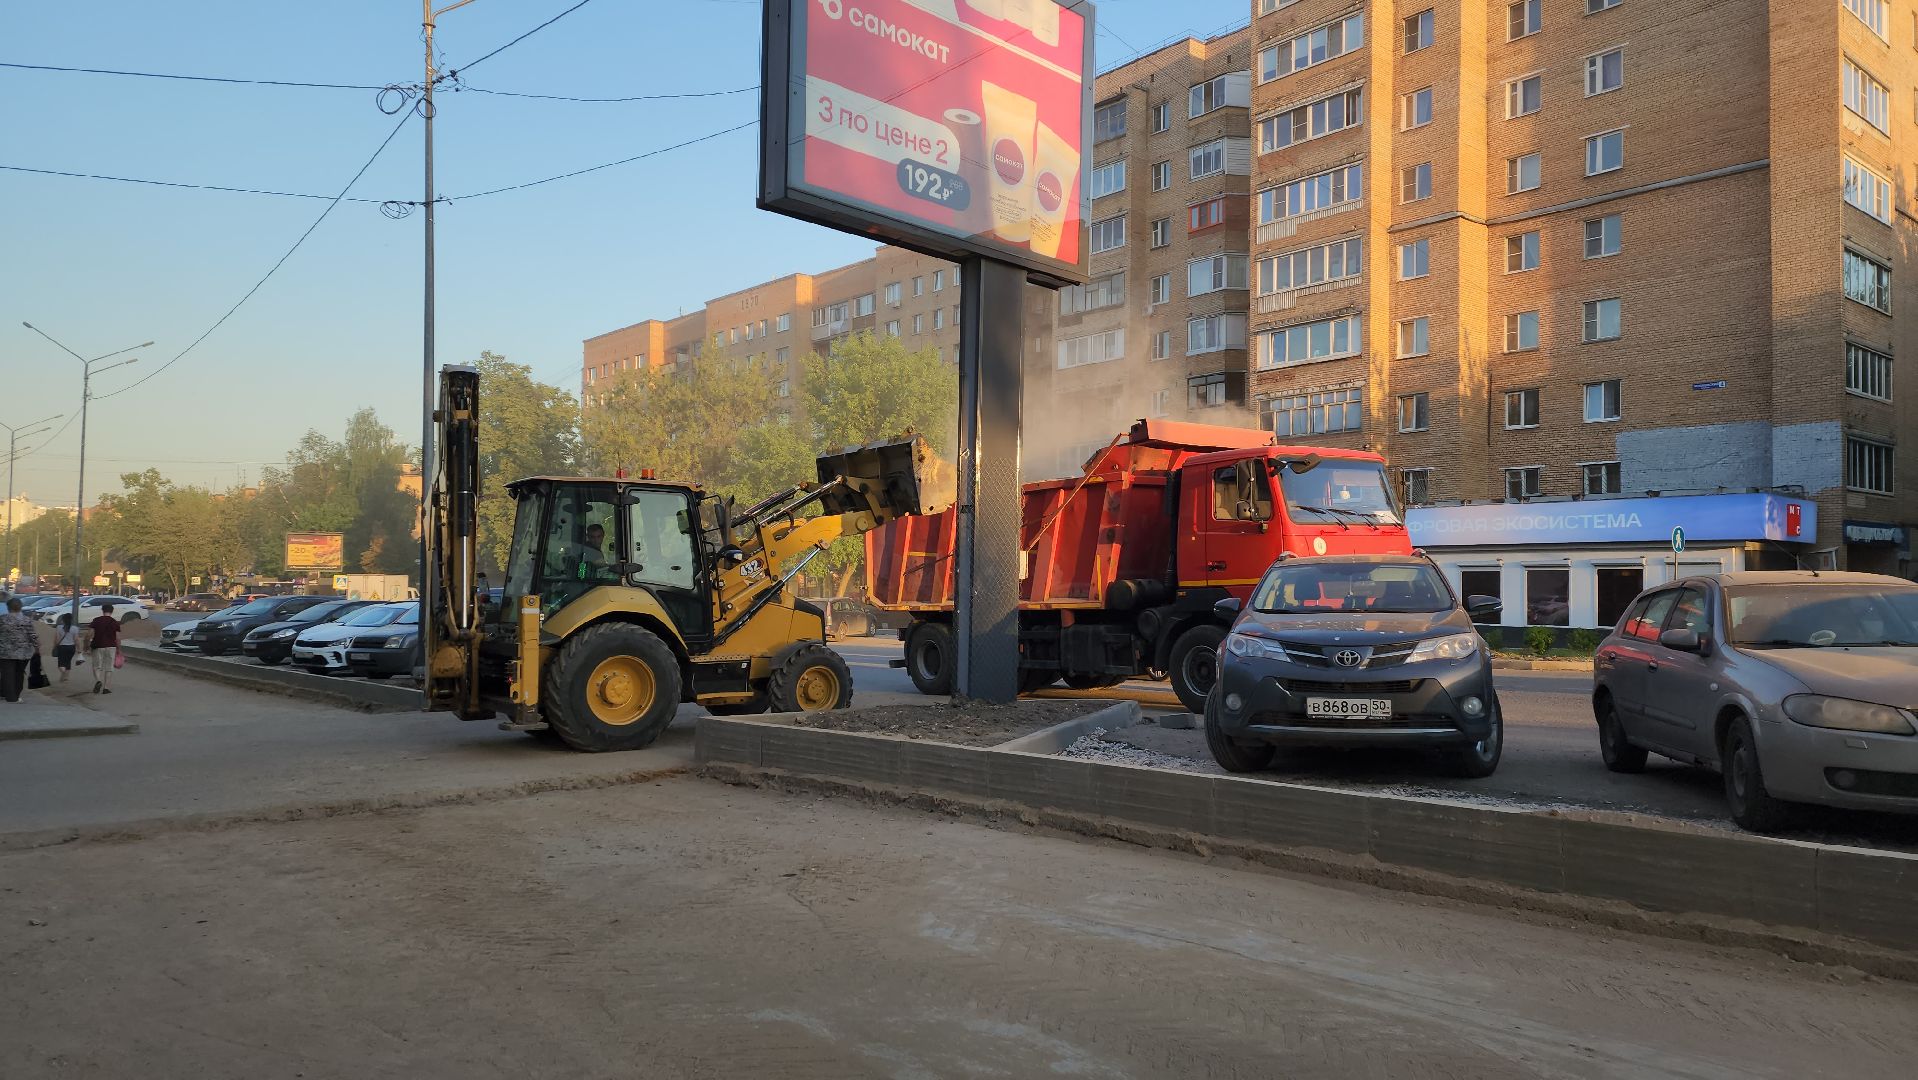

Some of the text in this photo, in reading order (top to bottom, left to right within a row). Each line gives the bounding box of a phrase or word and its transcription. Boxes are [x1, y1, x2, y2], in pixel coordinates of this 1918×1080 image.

[848, 7, 950, 64] самокат
[818, 96, 948, 165] 3 по цене 2
[1492, 512, 1643, 531] ЭКОСИСТЕМА
[1372, 700, 1386, 711] 50
